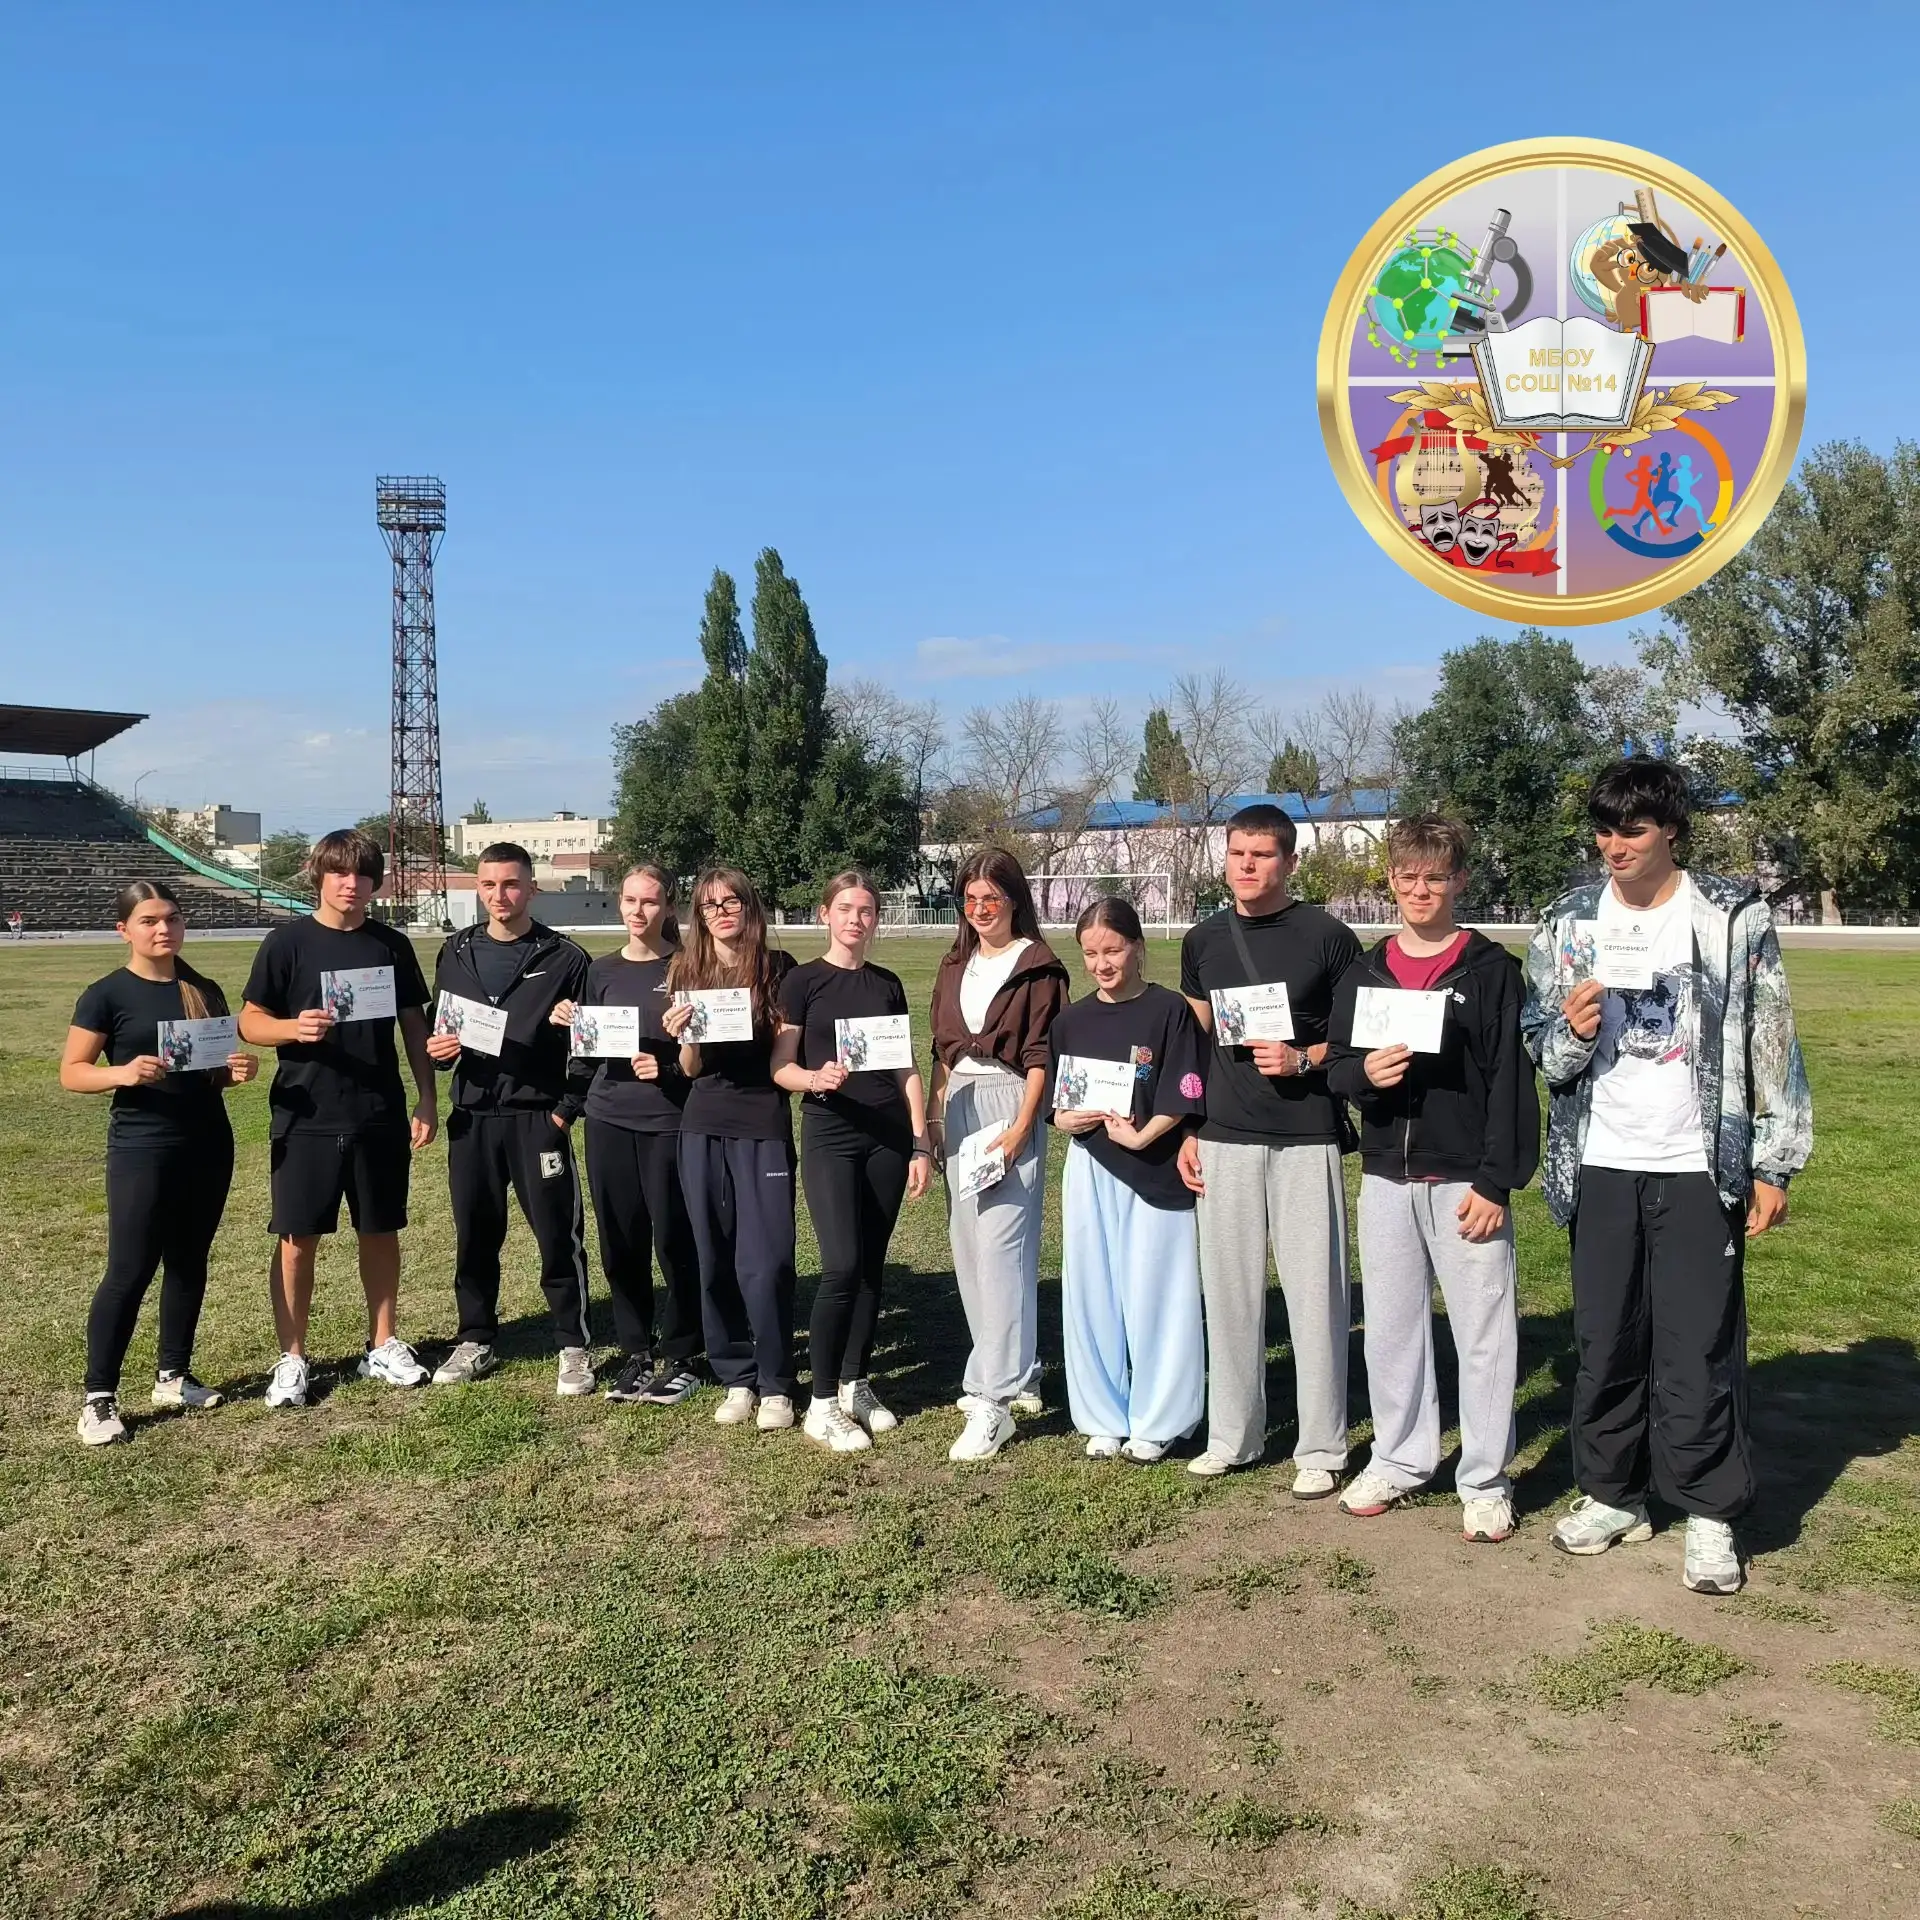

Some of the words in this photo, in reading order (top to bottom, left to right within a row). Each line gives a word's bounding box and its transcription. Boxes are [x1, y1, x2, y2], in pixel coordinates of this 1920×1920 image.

[1604, 944, 1649, 952] СЕРТИФИКАТ
[712, 1006, 747, 1014] СЕРТИФИКАТ
[1248, 1003, 1285, 1012] СЕРТИФИКАТ
